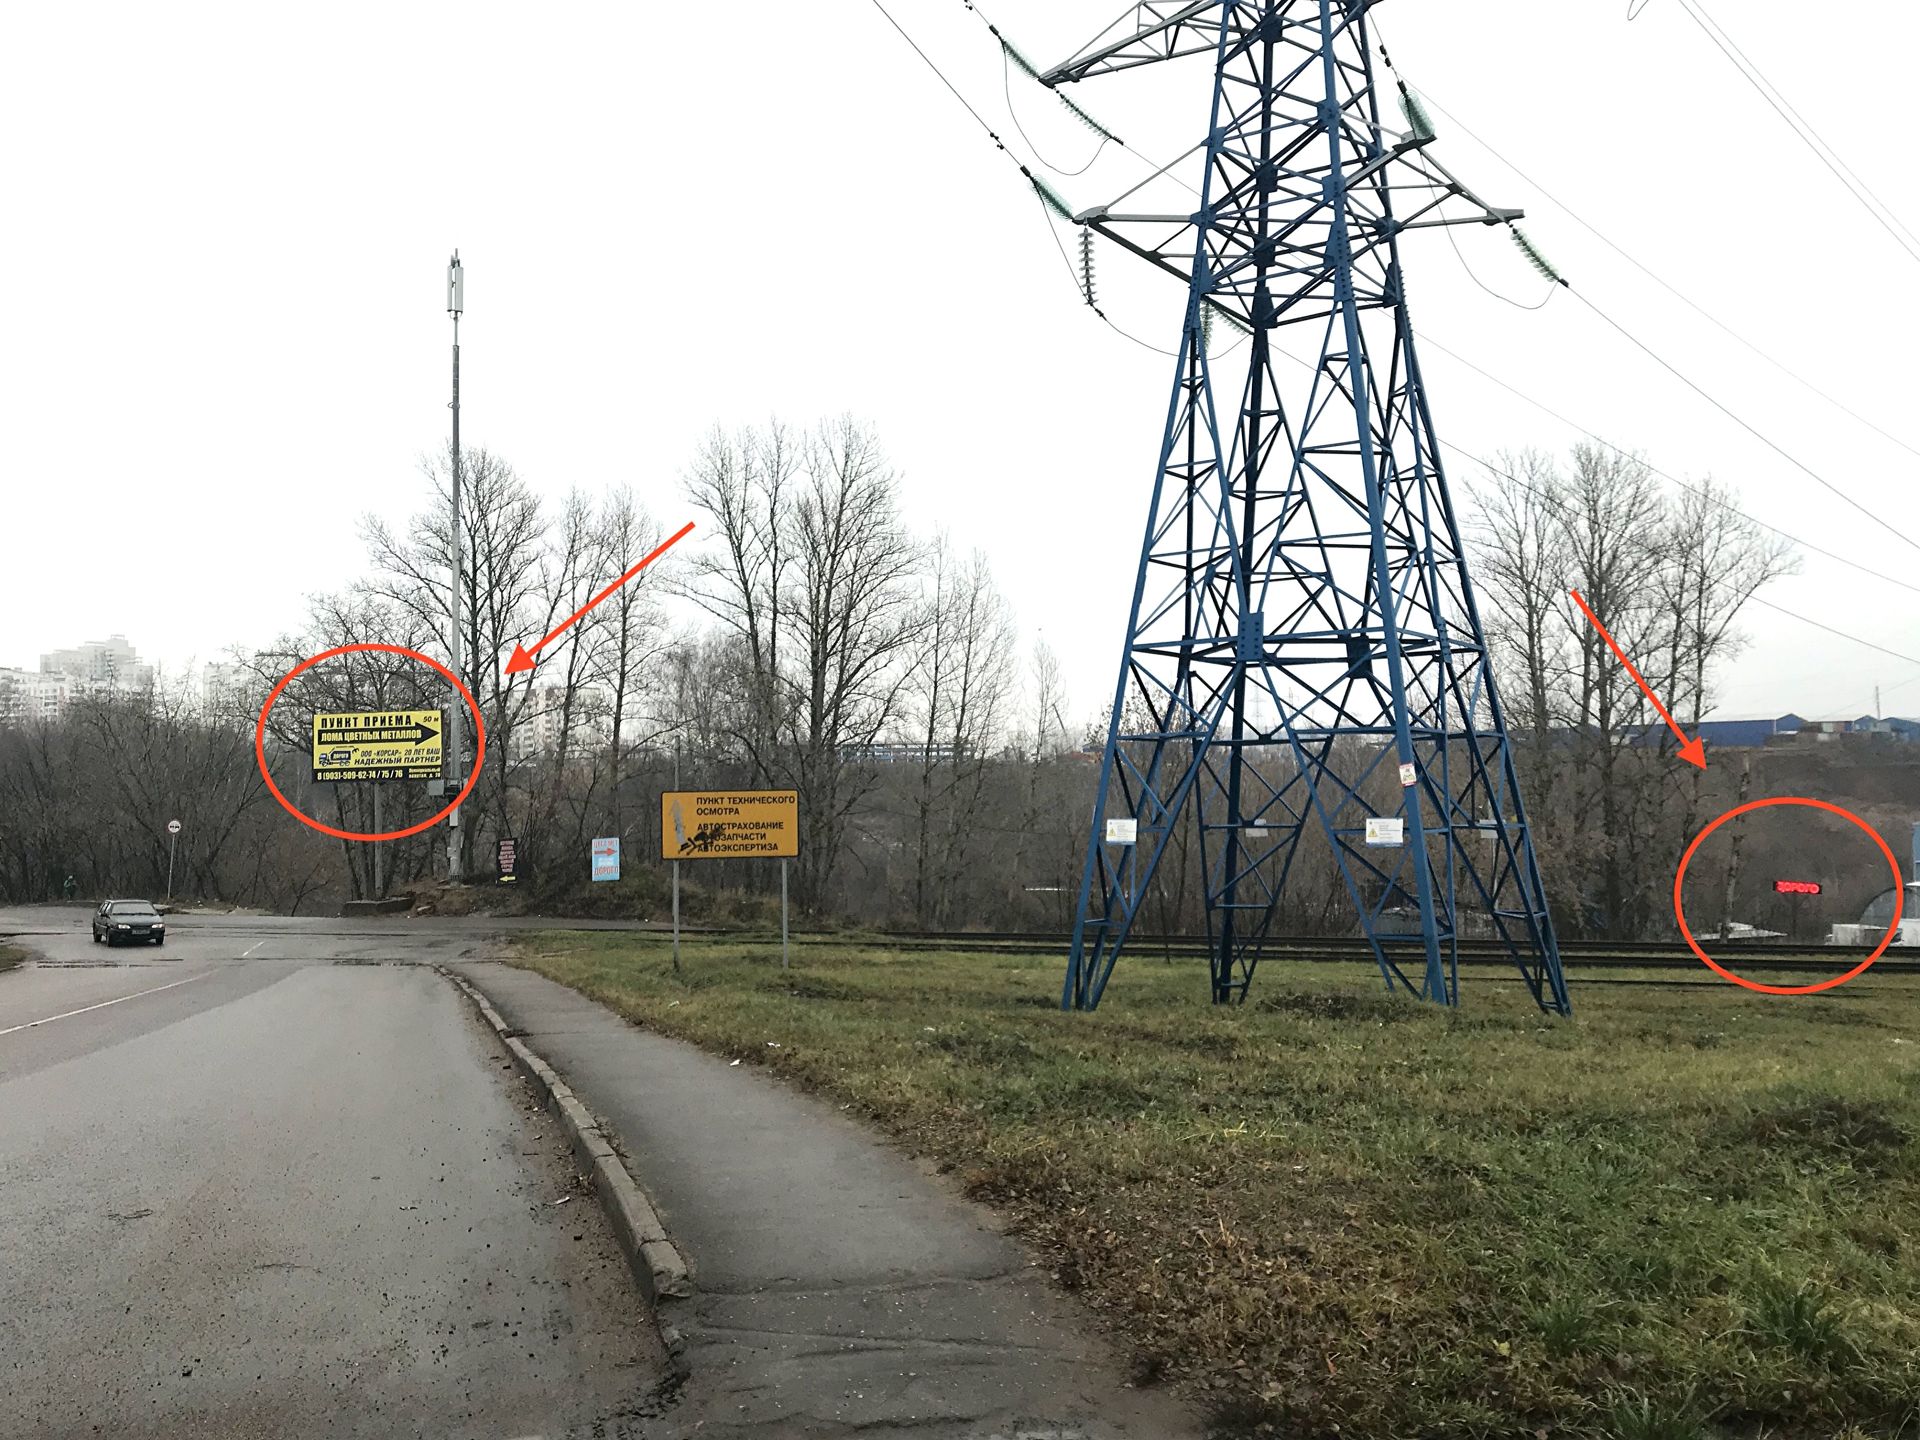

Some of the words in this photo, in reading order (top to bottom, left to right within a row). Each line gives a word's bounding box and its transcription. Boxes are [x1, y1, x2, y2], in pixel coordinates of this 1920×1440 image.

[322, 717, 358, 728] ПУНКТ
[364, 715, 412, 726] ПРИЕМА
[321, 732, 343, 742] ЛОМА
[344, 731, 380, 742] ЦВЕТНЫХ
[381, 729, 422, 740] МЕТАЛЛОВ
[728, 796, 795, 804] ТЕХНИЧЕСКОГО
[697, 822, 784, 831] АВТОСТРАХОВАНИЕ
